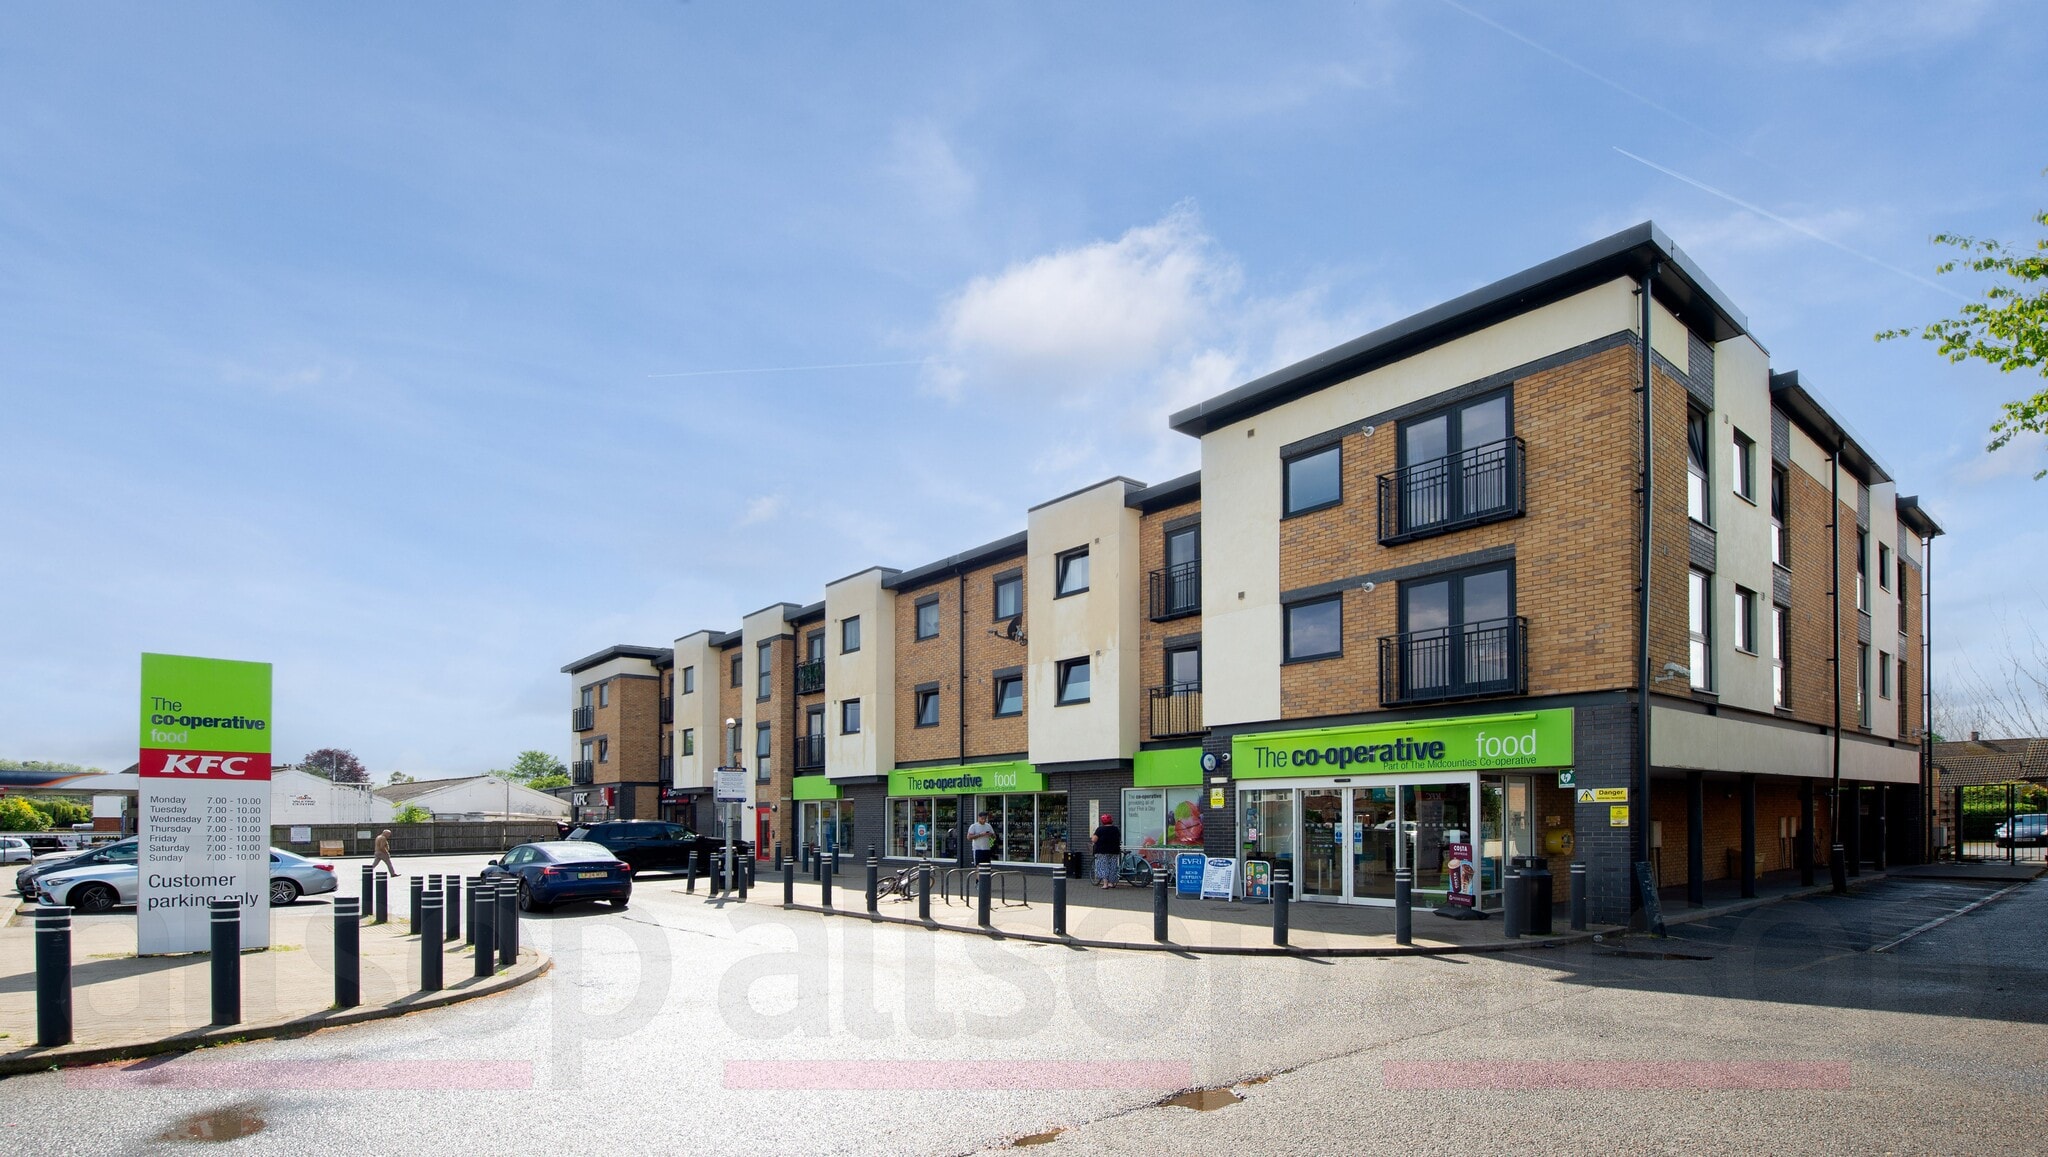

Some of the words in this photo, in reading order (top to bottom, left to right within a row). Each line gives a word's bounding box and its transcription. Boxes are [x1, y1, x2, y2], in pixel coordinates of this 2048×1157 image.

[151, 696, 182, 712] The
[151, 714, 265, 730] co-operative
[151, 728, 188, 744] food
[1253, 746, 1288, 768] The
[1291, 737, 1446, 769] co-operative
[1475, 729, 1536, 758] food
[160, 754, 249, 775] KFC
[1383, 762, 1399, 771] Part
[1400, 761, 1408, 769] of
[1410, 760, 1425, 769] The
[1427, 758, 1477, 768] Midcounties
[1480, 756, 1537, 767] Co-operative
[908, 776, 923, 790] The
[923, 774, 982, 791] co-operative
[994, 771, 1016, 786] food
[150, 796, 186, 805] Monday
[573, 792, 588, 806] KFC
[150, 805, 187, 814] Tuesday
[207, 806, 227, 814] 7.00
[237, 806, 261, 814] 10.00
[150, 815, 202, 824] Wednesday
[207, 815, 227, 823] 7.00
[237, 815, 261, 823] 10.00
[150, 825, 192, 834] Thursday
[207, 825, 227, 833] 7.00
[237, 825, 261, 833] 10.00
[149, 834, 177, 843] Friday
[207, 834, 227, 842] 7.00
[237, 834, 261, 842] 10.00
[149, 844, 190, 853] Saturday
[207, 844, 227, 852] 7.00
[237, 844, 261, 852] 10.00
[149, 854, 183, 862] Sunday
[207, 853, 227, 861] 7.00
[237, 853, 261, 861] 10.00
[148, 874, 236, 888] Customer
[148, 894, 217, 911] parking
